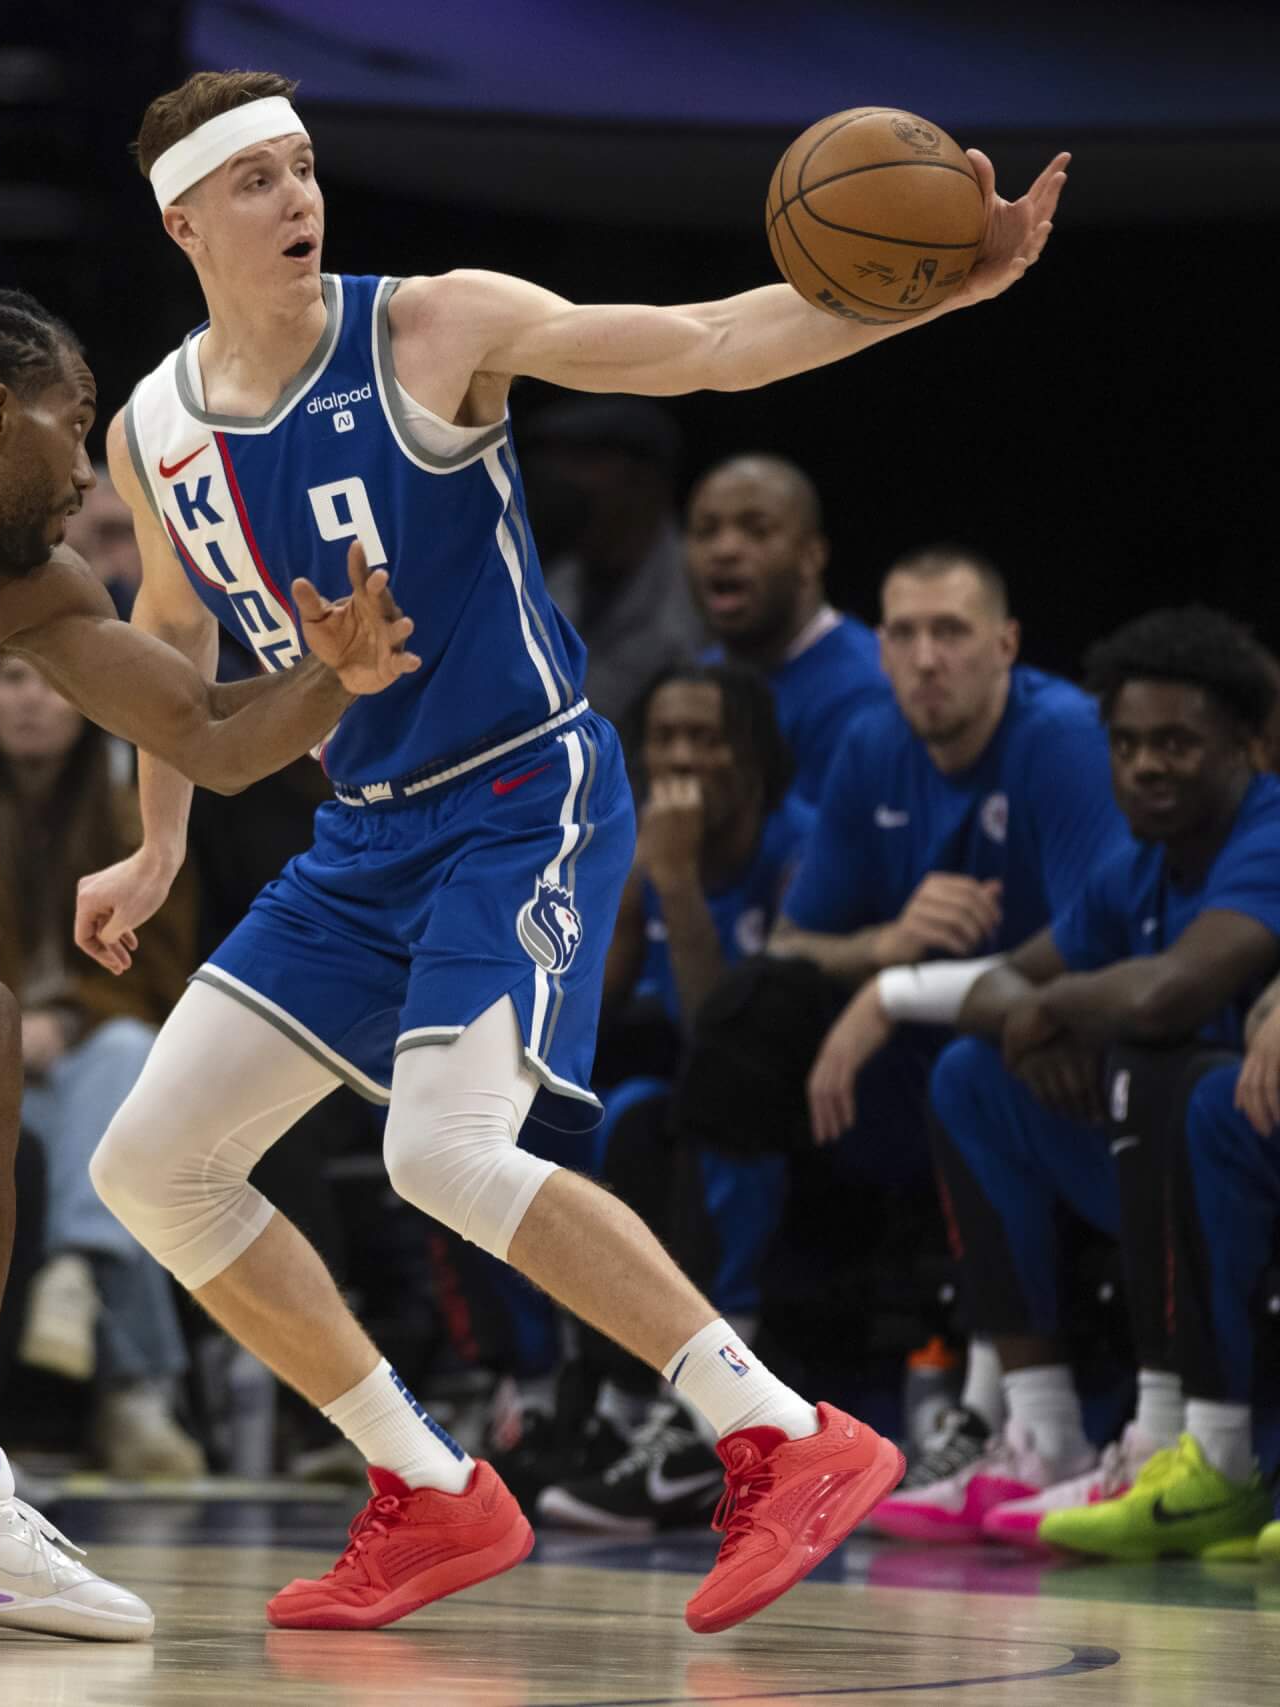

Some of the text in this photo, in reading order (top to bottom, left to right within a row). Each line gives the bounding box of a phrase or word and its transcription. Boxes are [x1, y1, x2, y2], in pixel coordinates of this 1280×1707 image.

[306, 381, 373, 414] dialpad
[306, 475, 388, 568] 9
[172, 474, 303, 672] KING
